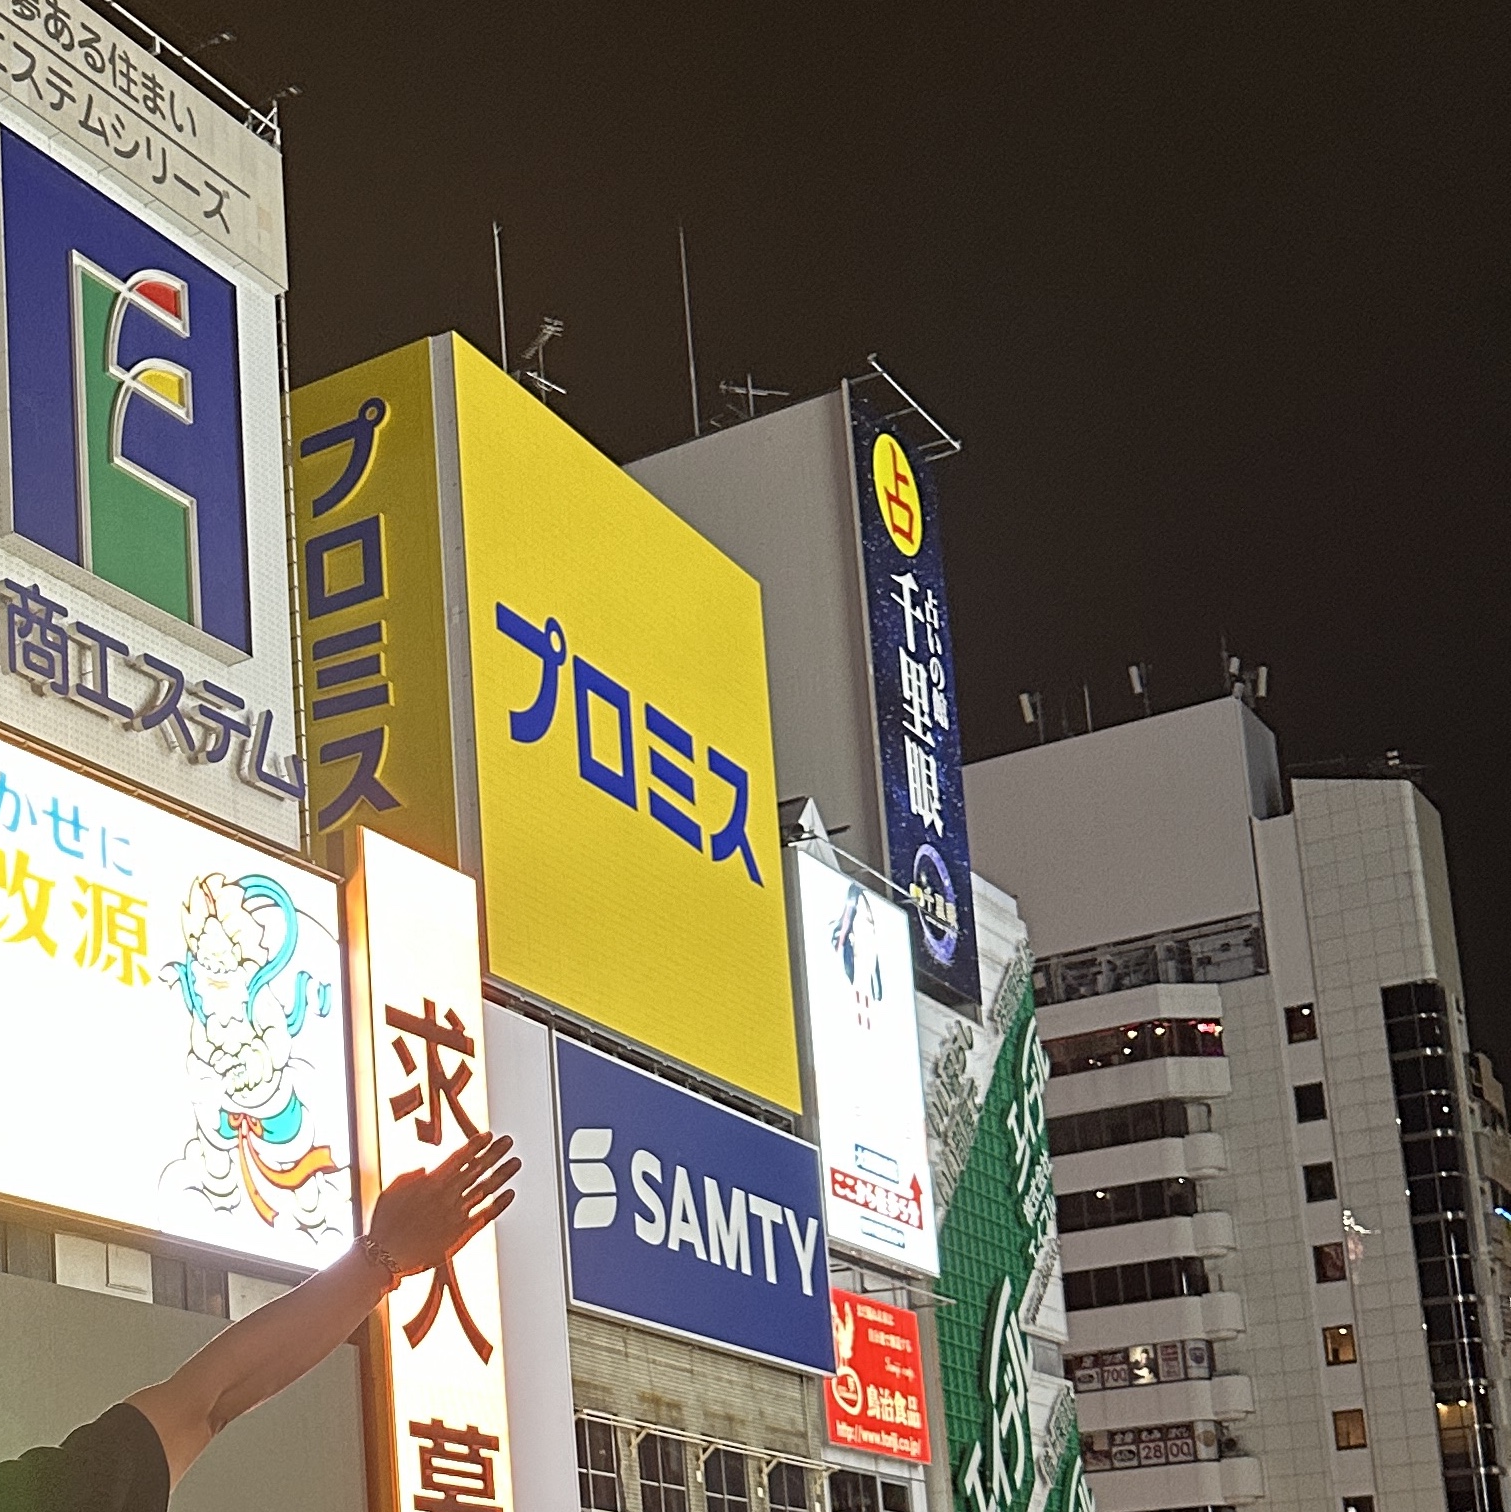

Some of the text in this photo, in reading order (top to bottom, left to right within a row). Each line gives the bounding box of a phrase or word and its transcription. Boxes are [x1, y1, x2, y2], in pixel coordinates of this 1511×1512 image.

[299, 396, 401, 831] プロミス
[495, 601, 764, 888] プロミス
[890, 572, 944, 838] 千里眼
[630, 1148, 819, 1297] SAMTY
